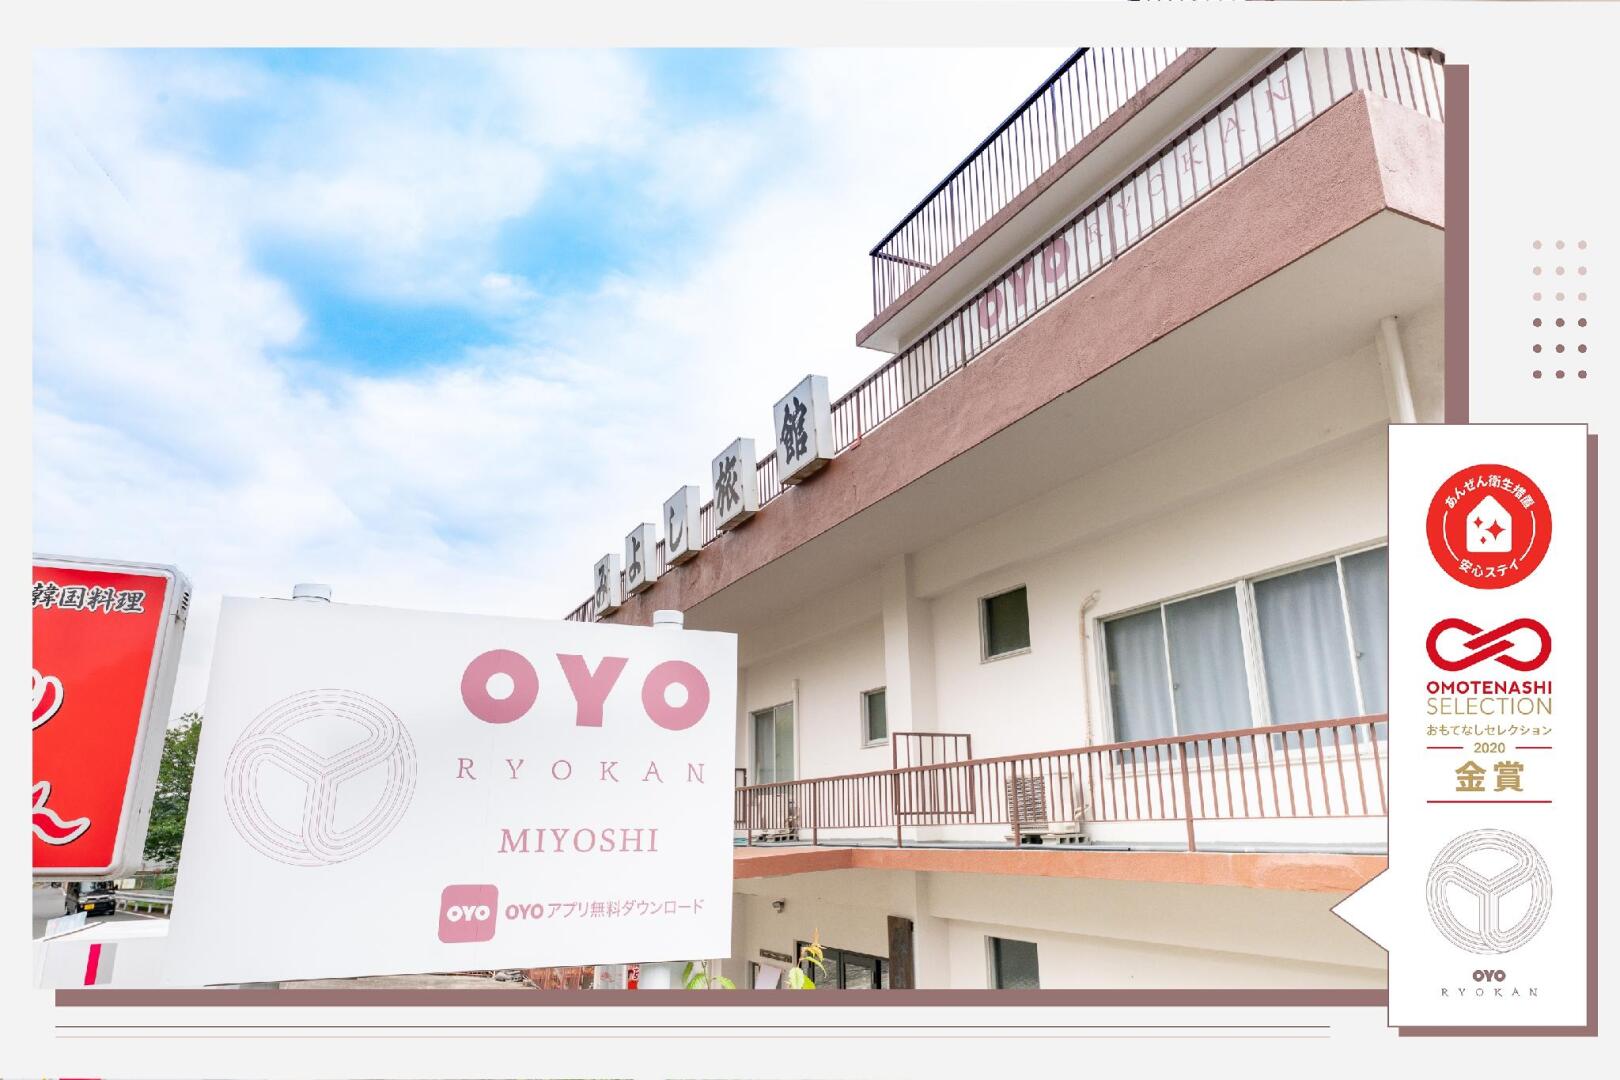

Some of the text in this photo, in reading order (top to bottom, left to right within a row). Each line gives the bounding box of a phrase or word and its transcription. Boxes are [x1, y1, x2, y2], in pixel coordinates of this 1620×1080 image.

[979, 237, 1070, 330] OYO
[596, 396, 808, 608] みよし旅館
[32, 581, 146, 614] 韓国料理
[460, 648, 711, 731] OYO
[456, 757, 706, 784] RYOKAN
[498, 828, 659, 853] MIYOSHI
[446, 904, 491, 922] OYO
